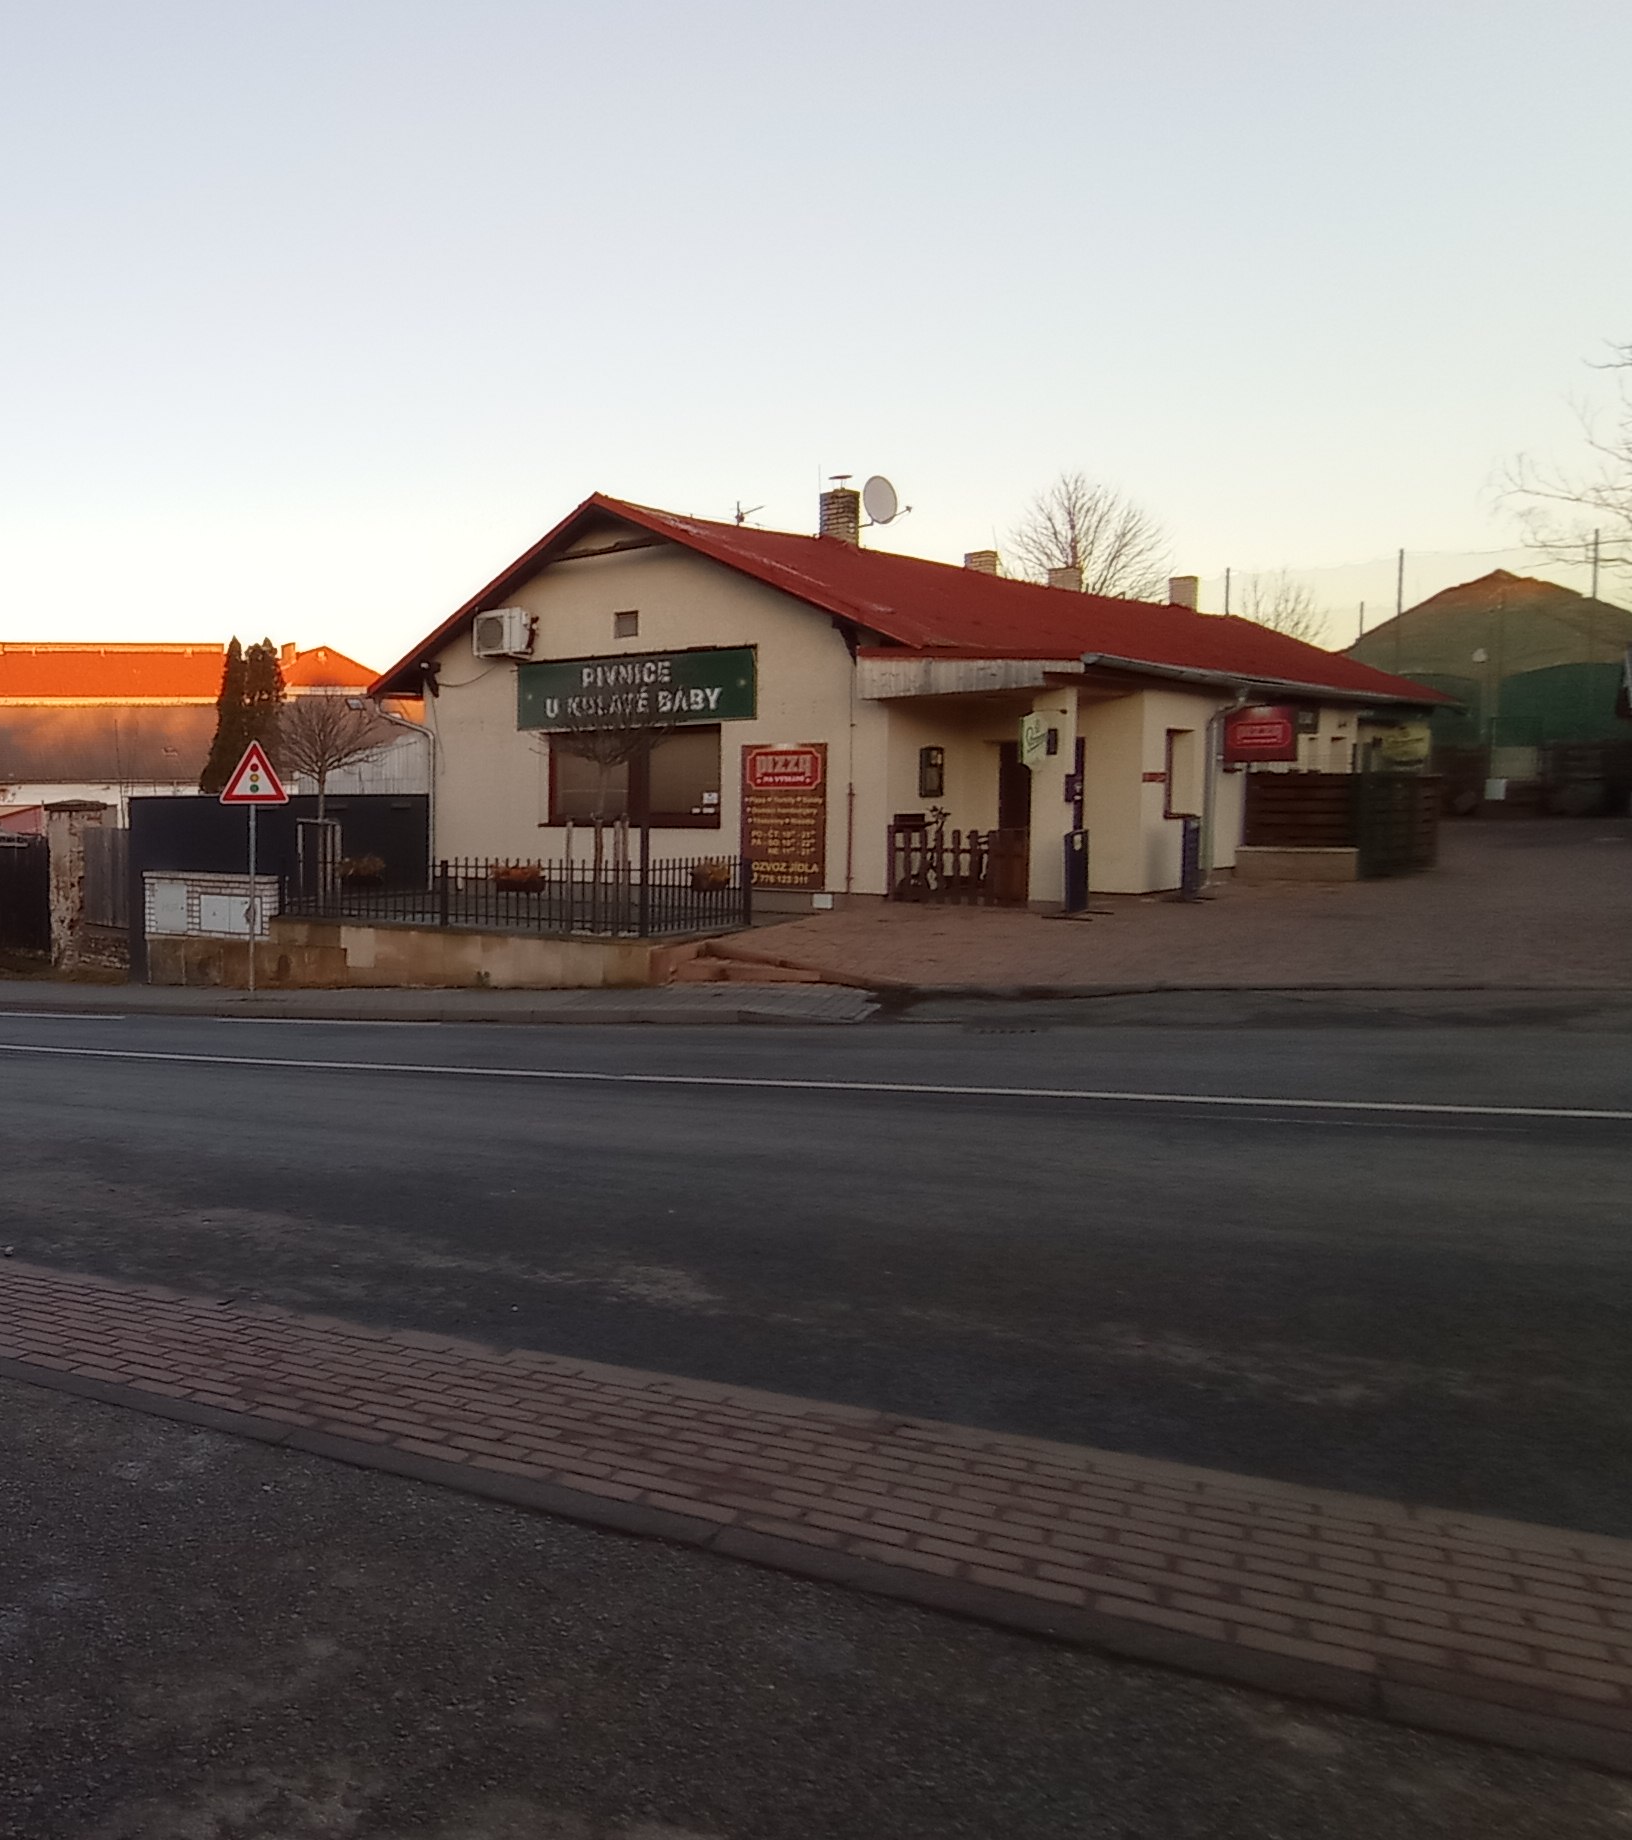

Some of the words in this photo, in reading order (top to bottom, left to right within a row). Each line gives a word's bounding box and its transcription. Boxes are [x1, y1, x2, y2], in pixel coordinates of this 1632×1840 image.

[582, 661, 671, 688] PIVNICE
[545, 698, 559, 718] U
[749, 862, 787, 872] OZVOZ
